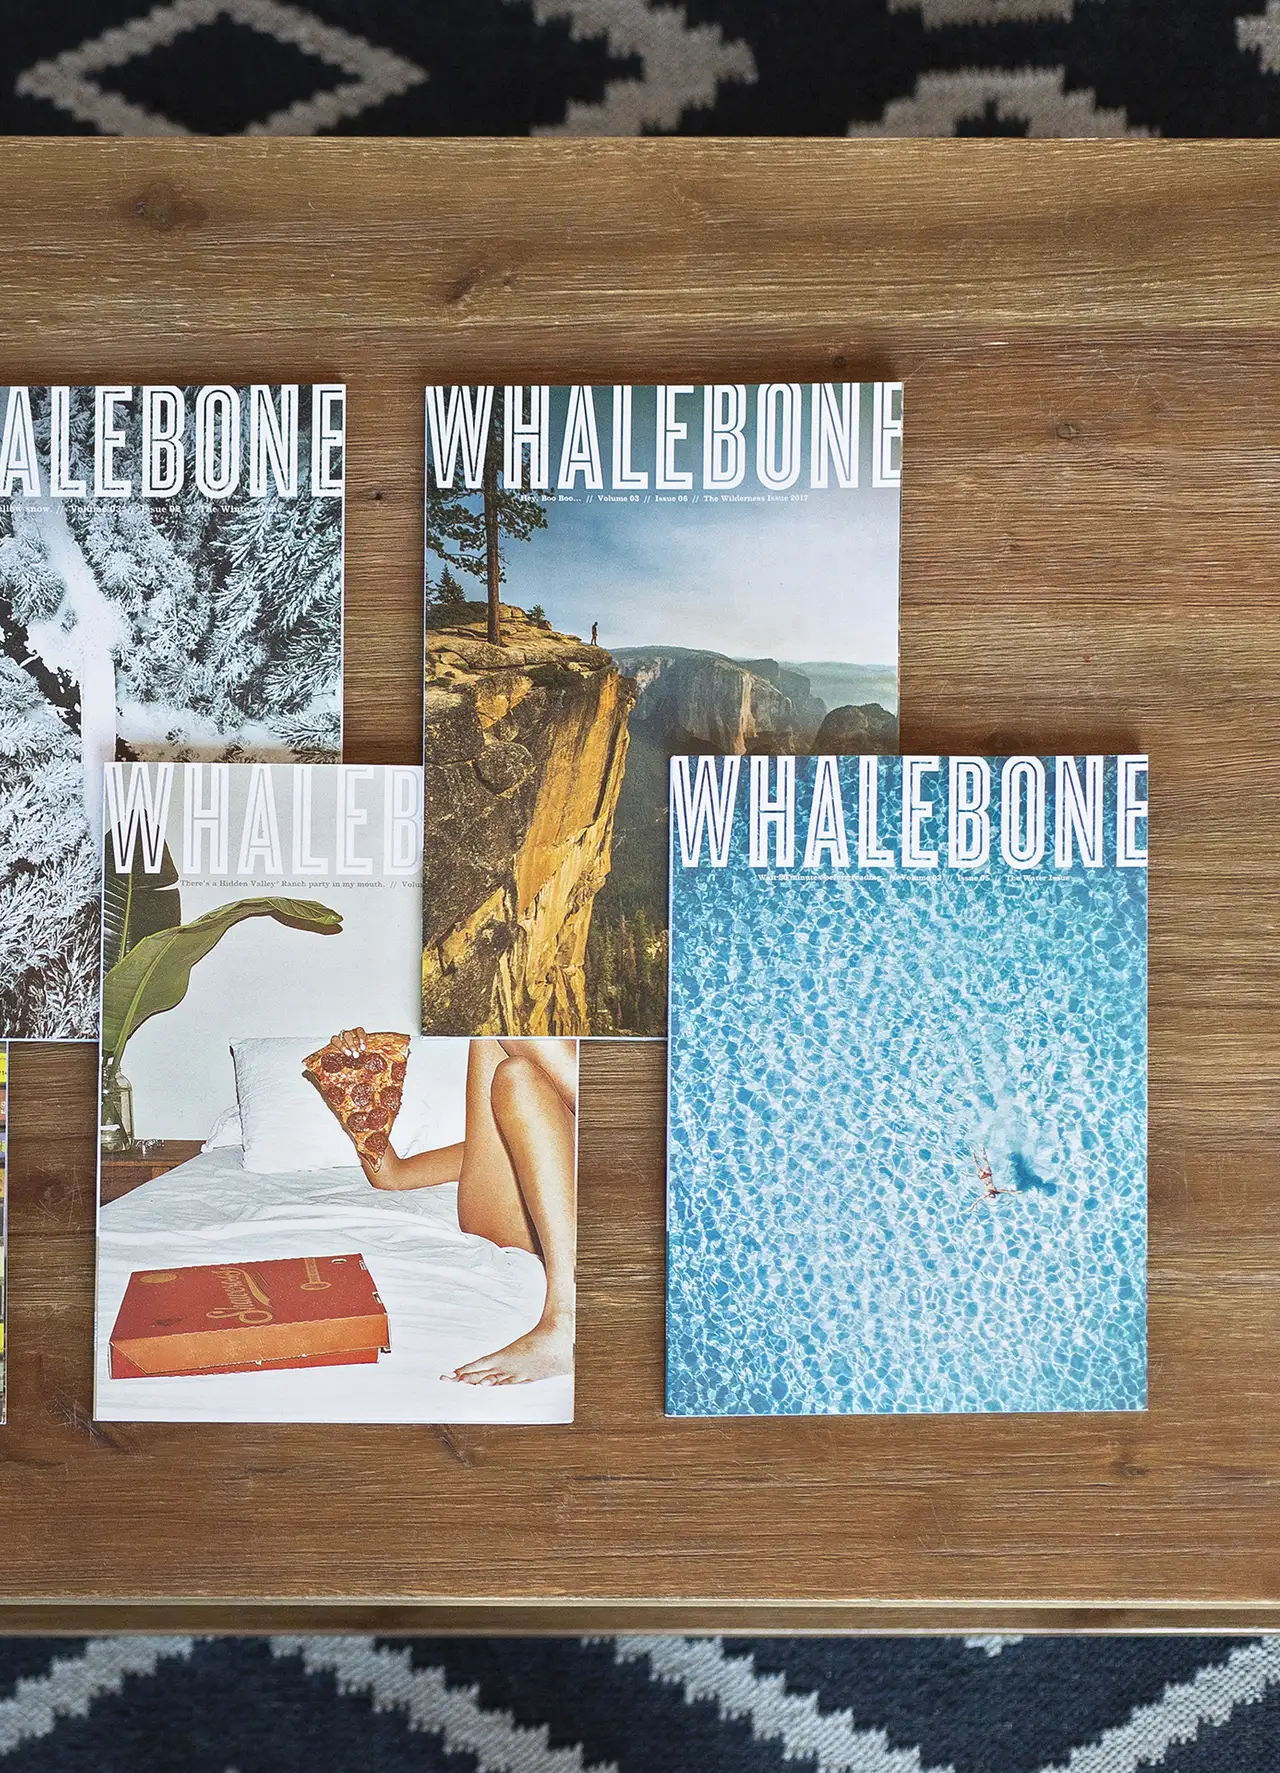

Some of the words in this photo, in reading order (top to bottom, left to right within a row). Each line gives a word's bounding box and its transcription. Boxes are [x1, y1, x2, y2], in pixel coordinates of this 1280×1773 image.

[425, 382, 903, 490] WHALEBONE
[25, 505, 53, 513] snow.
[70, 504, 107, 513] Volume
[221, 504, 254, 513] Winter
[791, 494, 808, 502] 2017
[104, 764, 423, 875] WHALEB
[672, 755, 1148, 869] WHALEBONE
[180, 880, 210, 888] There's
[219, 880, 248, 888] Hidden
[281, 880, 306, 888] Ranch
[308, 881, 331, 890] party
